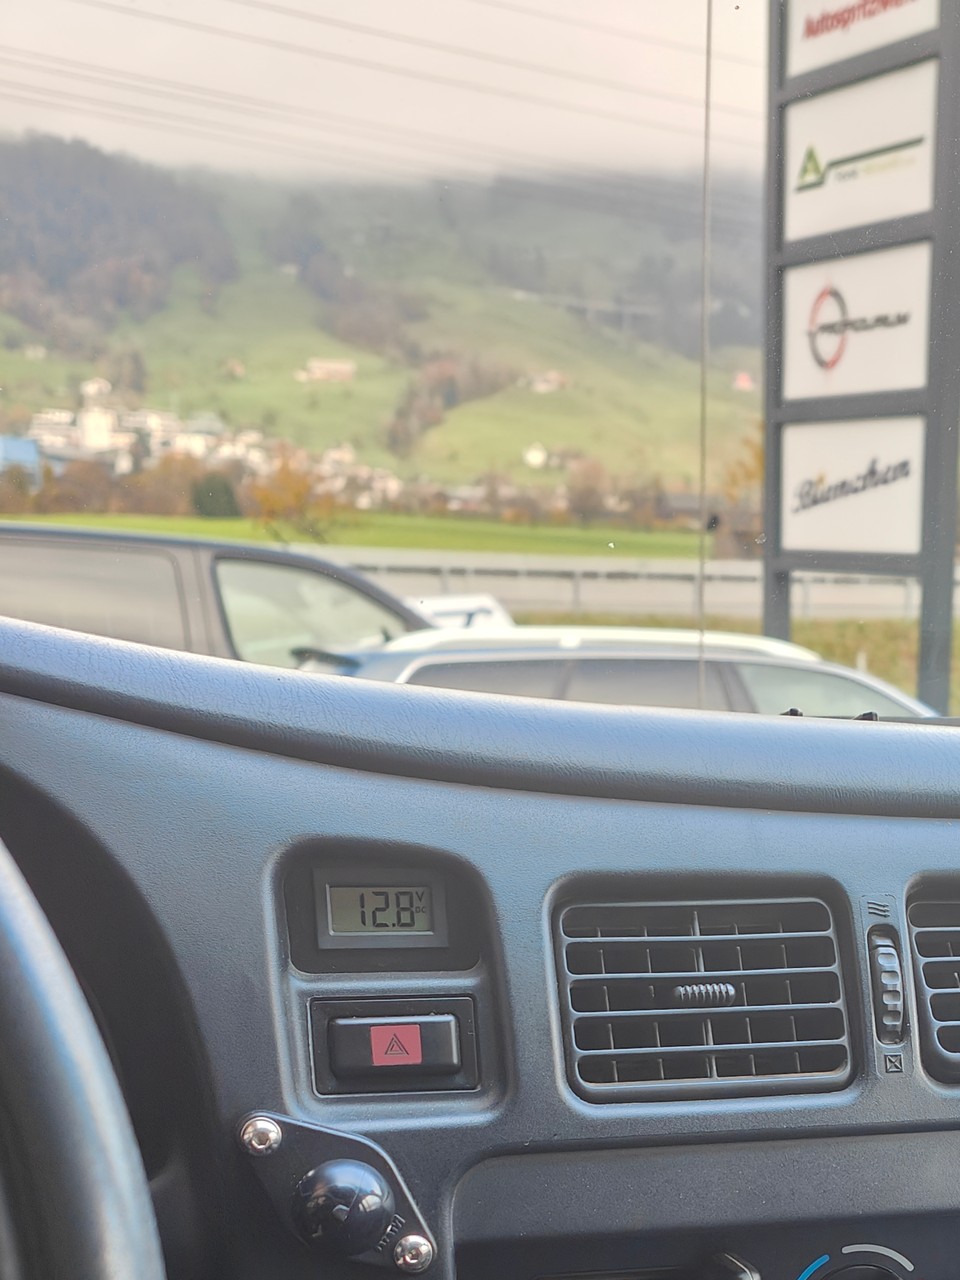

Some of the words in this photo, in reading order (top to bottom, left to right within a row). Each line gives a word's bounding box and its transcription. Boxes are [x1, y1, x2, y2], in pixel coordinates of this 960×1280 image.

[359, 891, 415, 928] 12.8
[415, 890, 425, 903] V
[415, 906, 427, 914] DC
